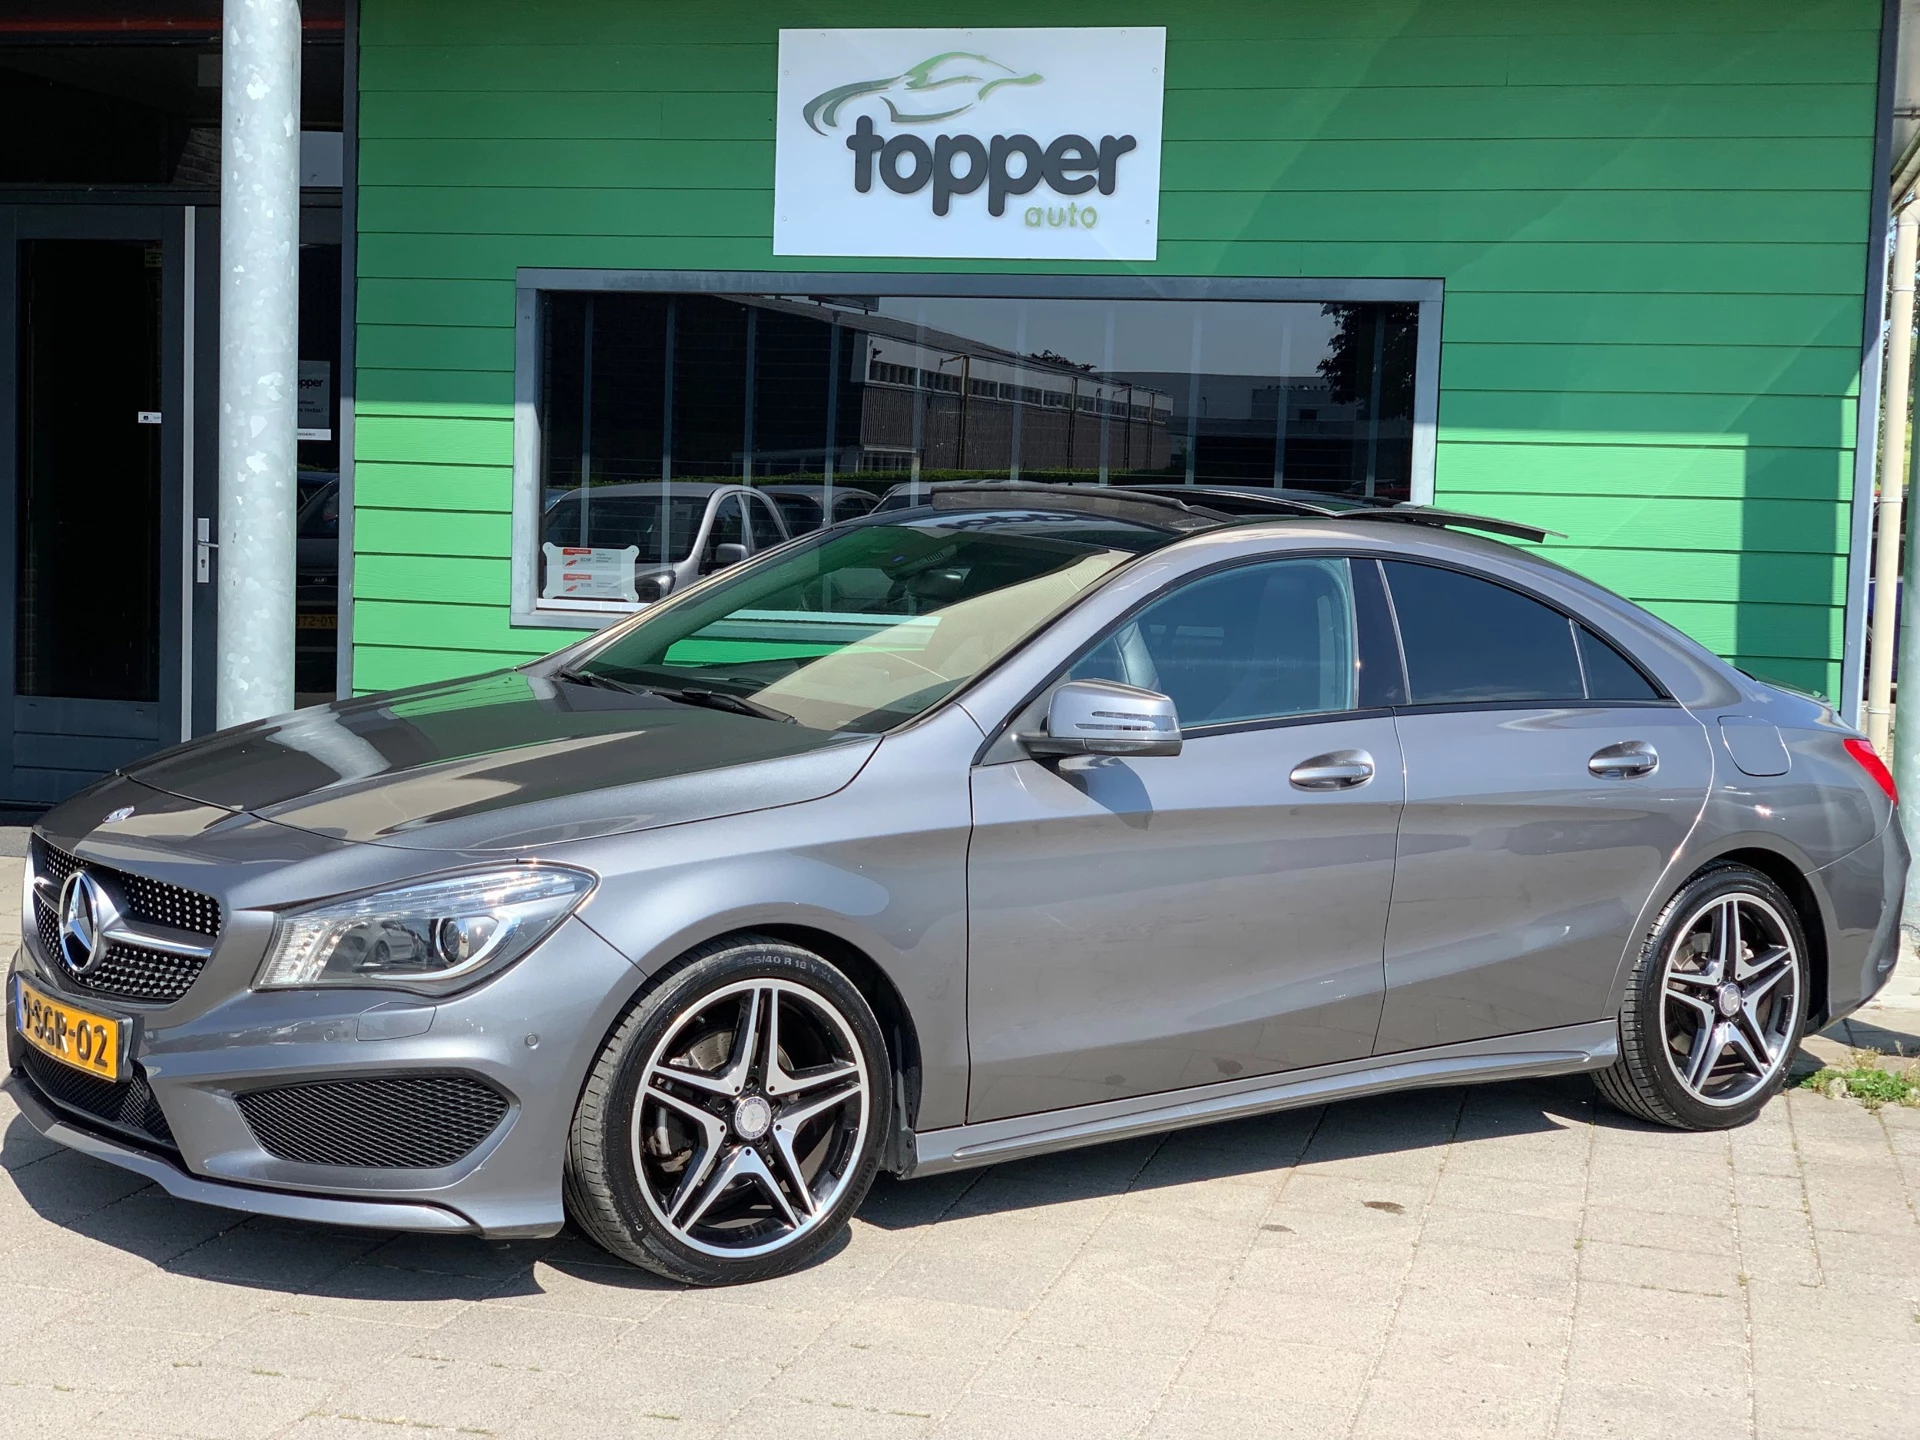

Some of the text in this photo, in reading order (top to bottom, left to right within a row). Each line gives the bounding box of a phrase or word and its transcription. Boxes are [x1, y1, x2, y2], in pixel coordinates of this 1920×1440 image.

[846, 115, 1137, 217] topper
[1024, 202, 1098, 229] auto
[23, 990, 108, 1068] 9-SGR-02
